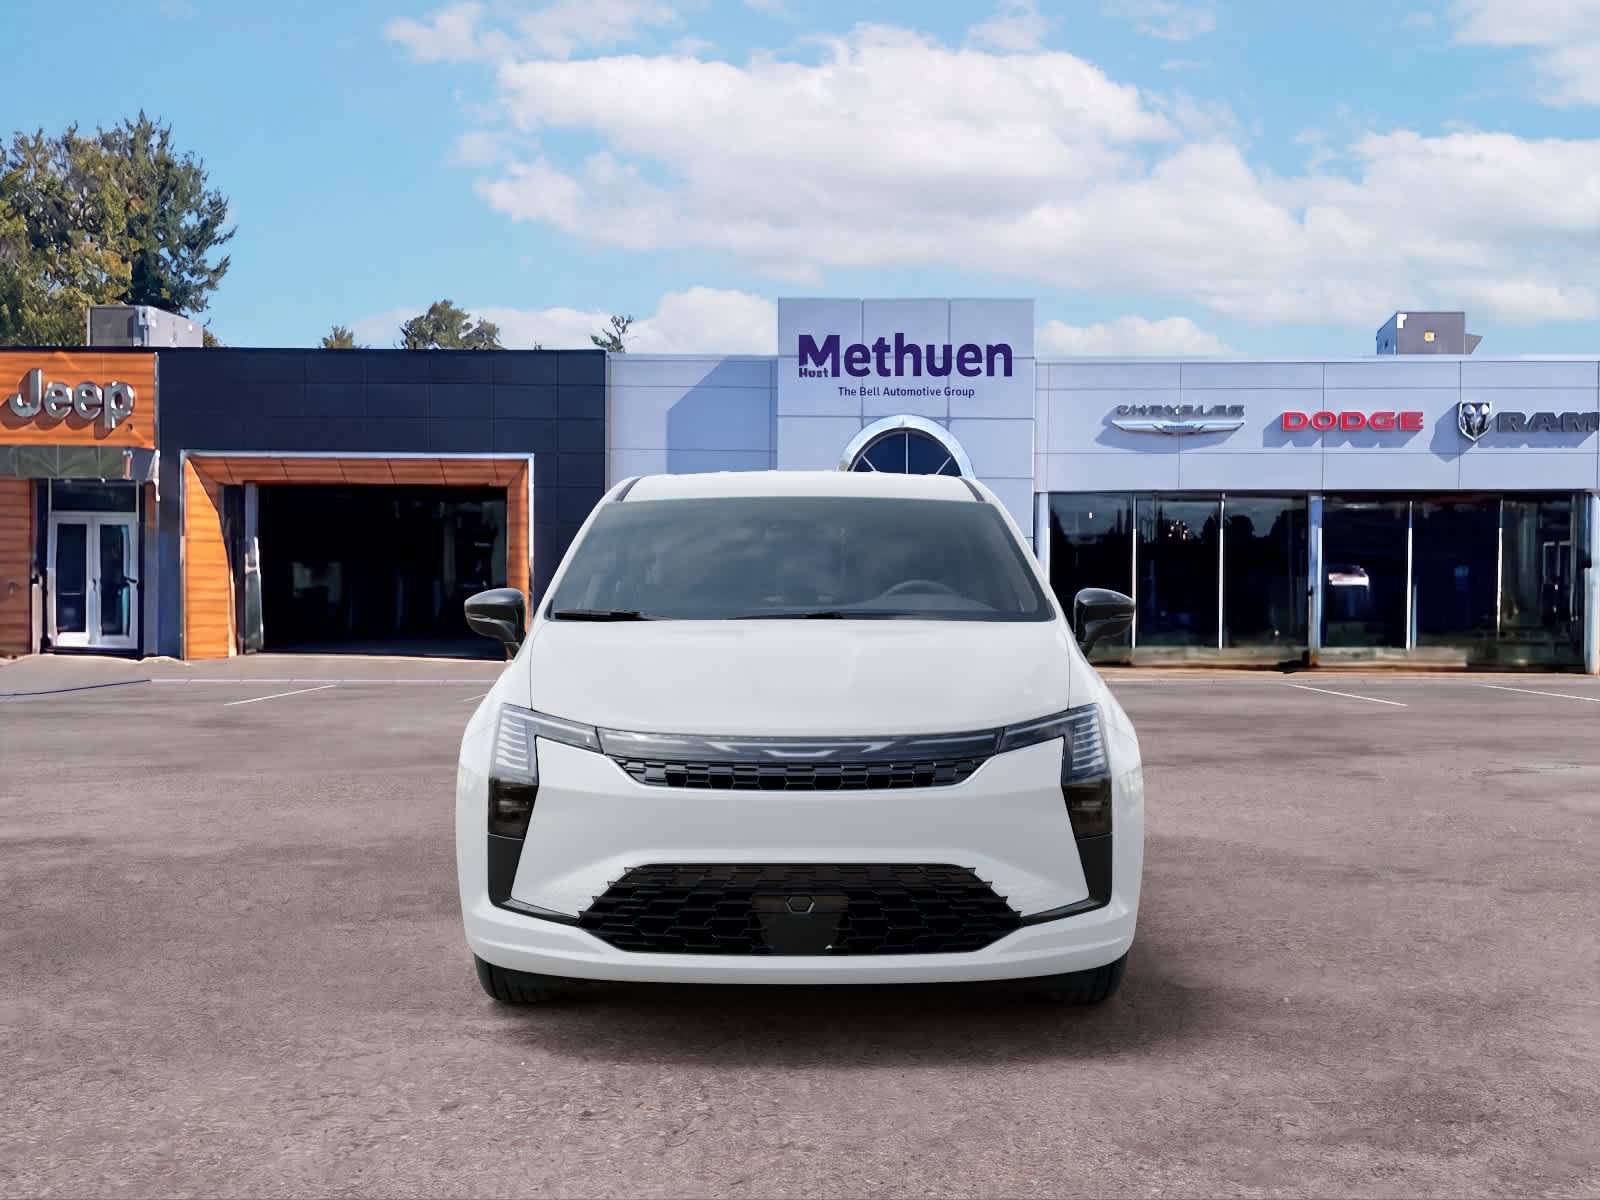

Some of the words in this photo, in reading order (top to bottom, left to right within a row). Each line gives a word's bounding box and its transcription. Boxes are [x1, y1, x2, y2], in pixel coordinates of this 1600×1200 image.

[798, 333, 1013, 378] Methuen
[9, 367, 134, 430] Jeep
[838, 386, 857, 397] The
[859, 386, 880, 397] Bell
[883, 386, 941, 397] Automotive
[943, 386, 975, 399] Group
[1282, 411, 1424, 431] DODGE
[1496, 411, 1599, 433] RAM
